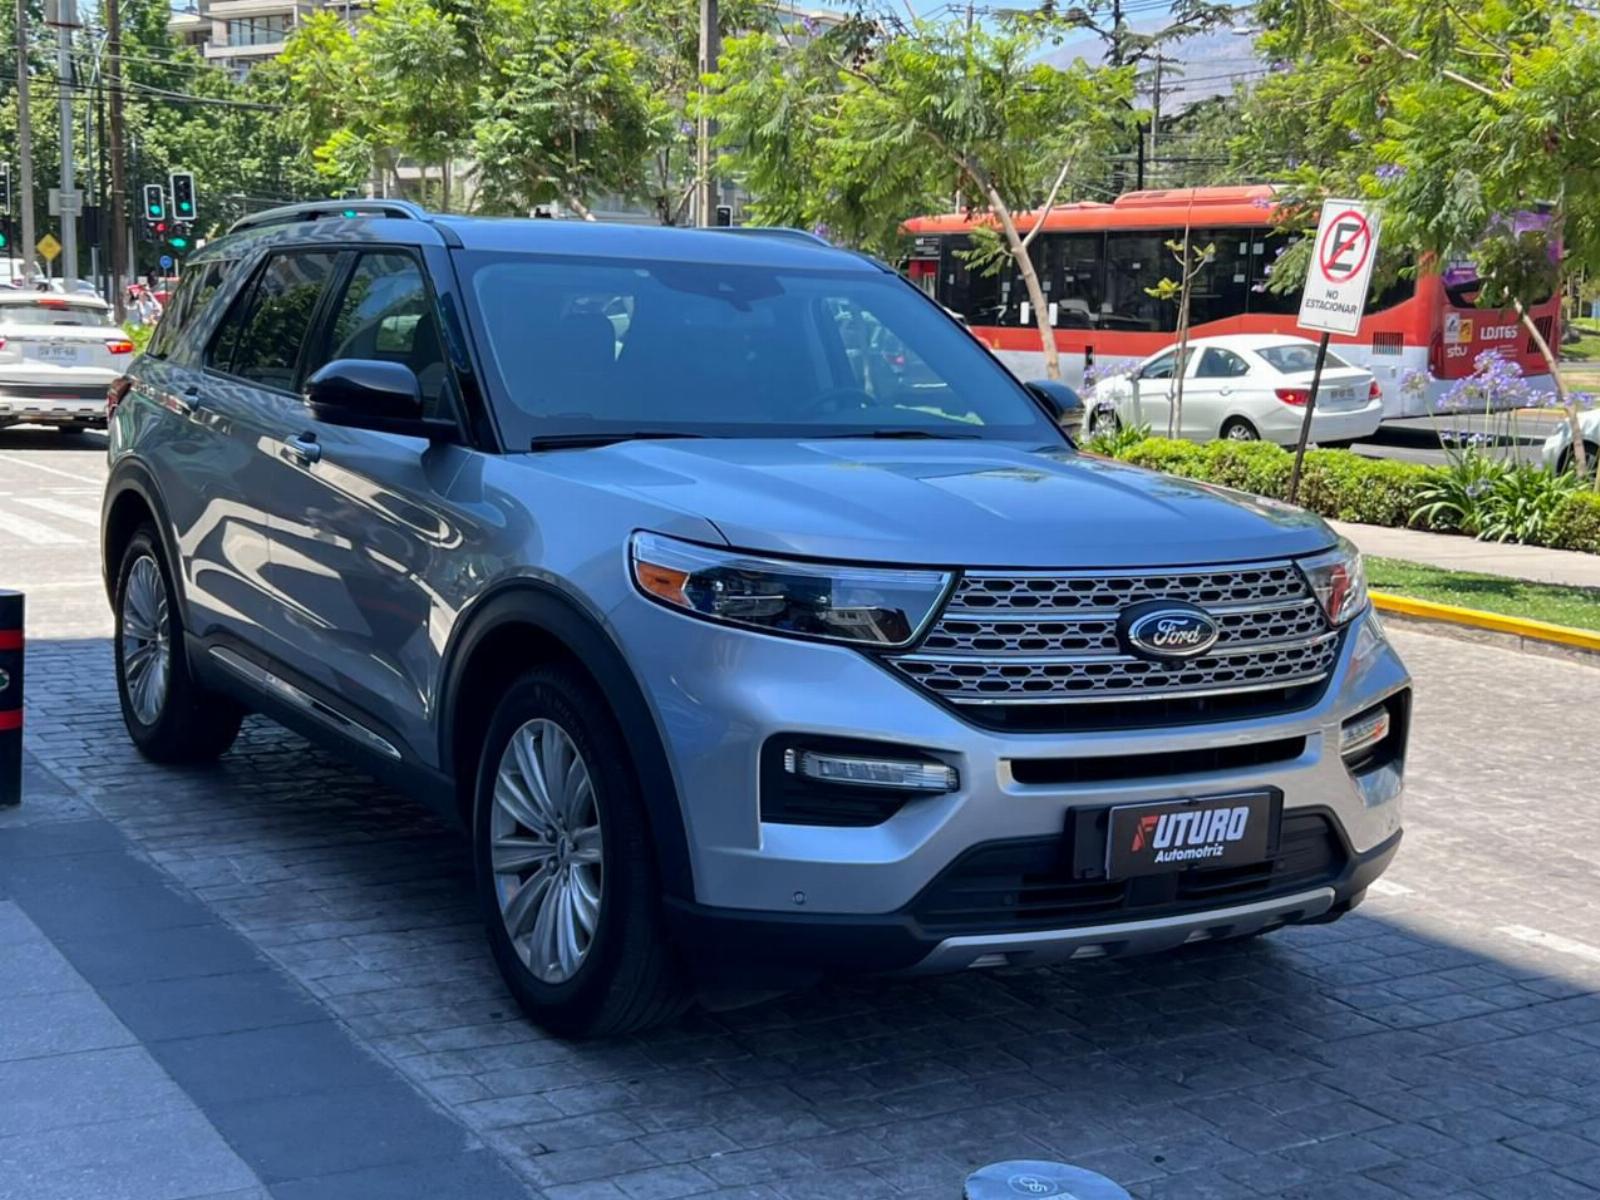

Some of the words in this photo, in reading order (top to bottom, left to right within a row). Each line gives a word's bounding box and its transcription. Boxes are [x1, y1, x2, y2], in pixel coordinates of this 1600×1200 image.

[1326, 290, 1339, 300] NO
[1305, 299, 1357, 315] ESTACIONAR
[1153, 619, 1201, 646] Ford
[1131, 806, 1249, 852] FUTURO
[1154, 843, 1224, 863] Automotriz
